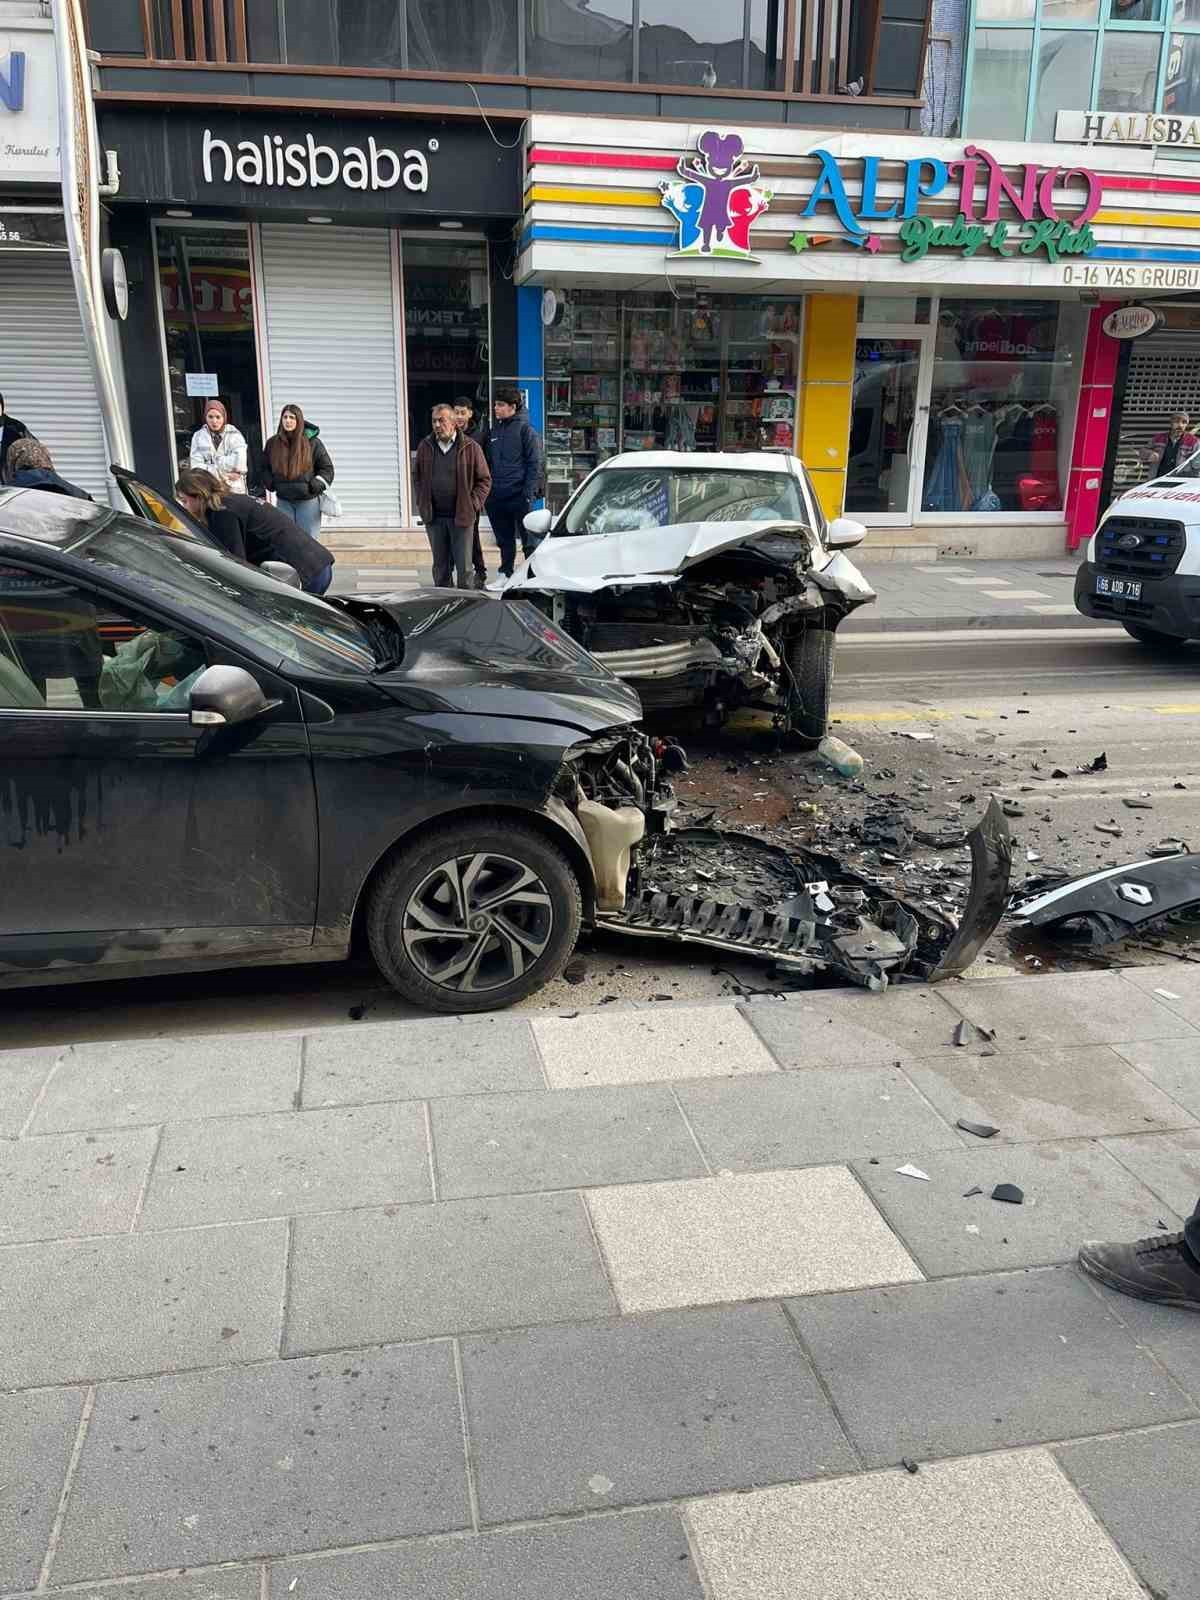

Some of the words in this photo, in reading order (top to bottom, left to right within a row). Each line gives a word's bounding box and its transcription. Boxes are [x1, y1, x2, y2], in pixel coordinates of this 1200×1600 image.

[202, 129, 428, 193] halisbaba
[899, 212, 987, 264] Baby
[1021, 219, 1100, 265] Kids
[1063, 265, 1099, 285] 0-16
[1142, 268, 1199, 288] GRUBU
